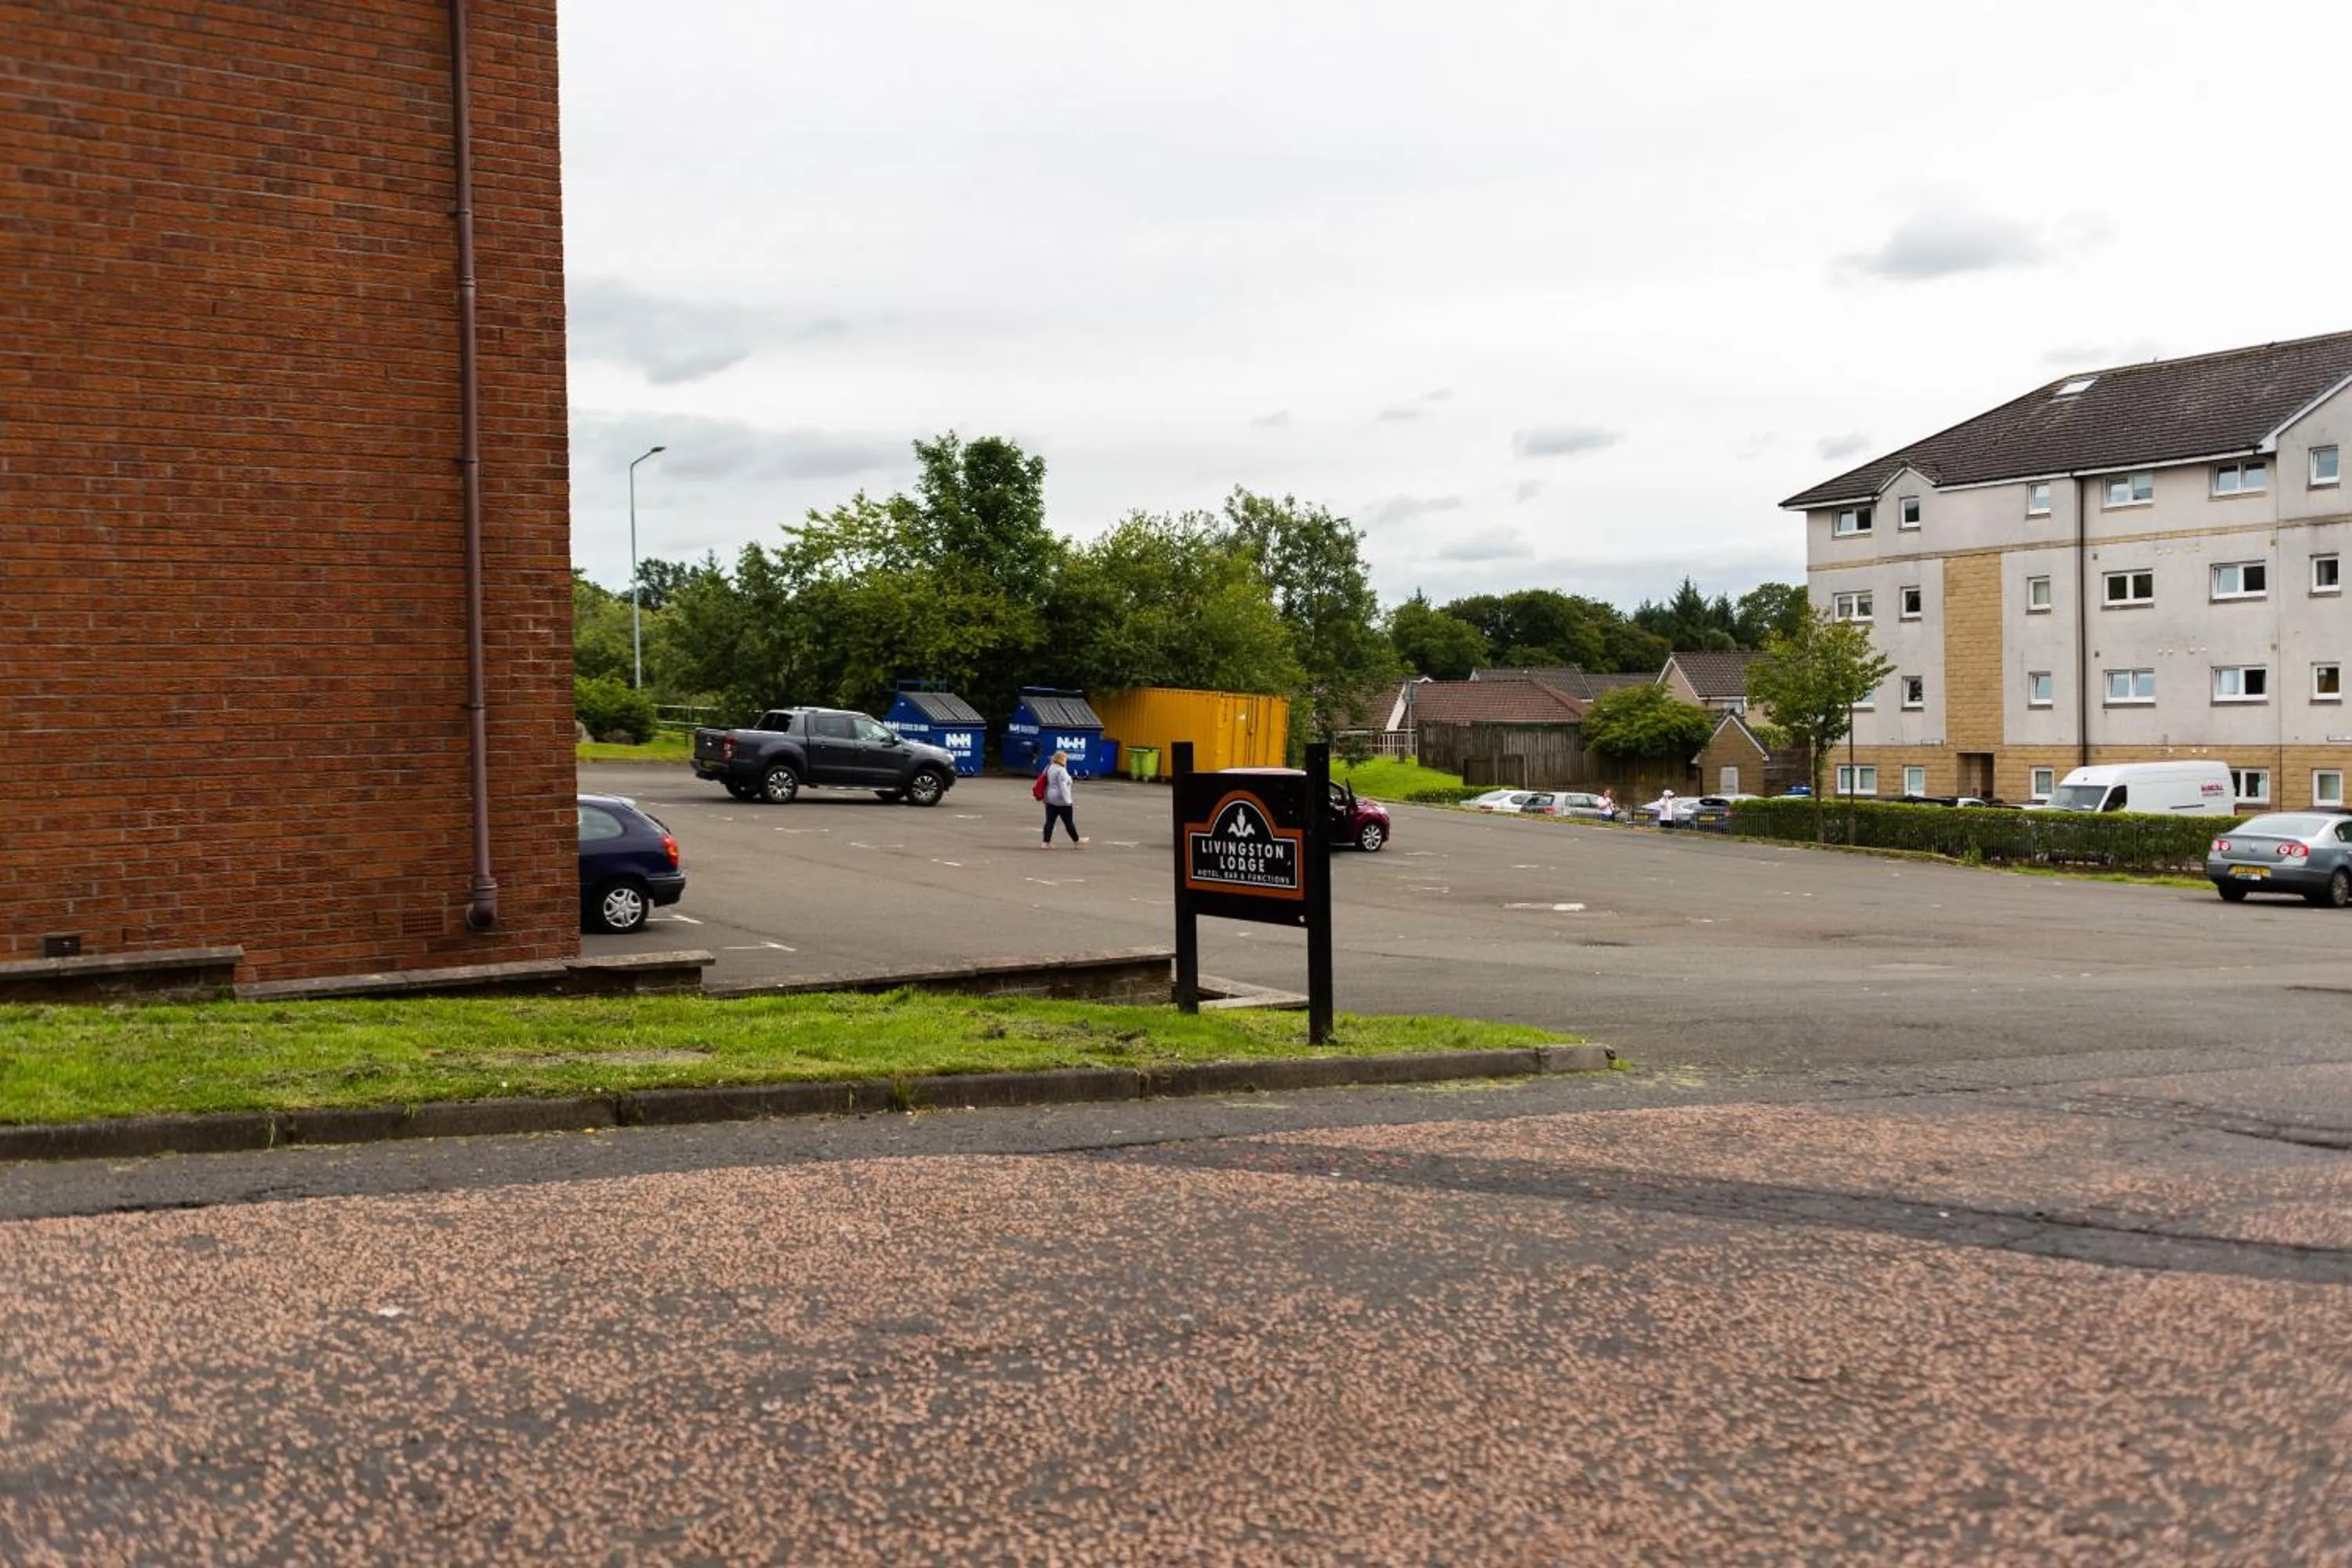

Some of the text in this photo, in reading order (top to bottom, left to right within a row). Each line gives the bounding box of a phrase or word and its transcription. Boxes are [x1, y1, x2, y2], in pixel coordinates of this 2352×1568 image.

[1202, 840, 1284, 858] LIVINGSTON
[1219, 855, 1265, 873] LODGE
[1247, 873, 1290, 884] FUNCTIONS
